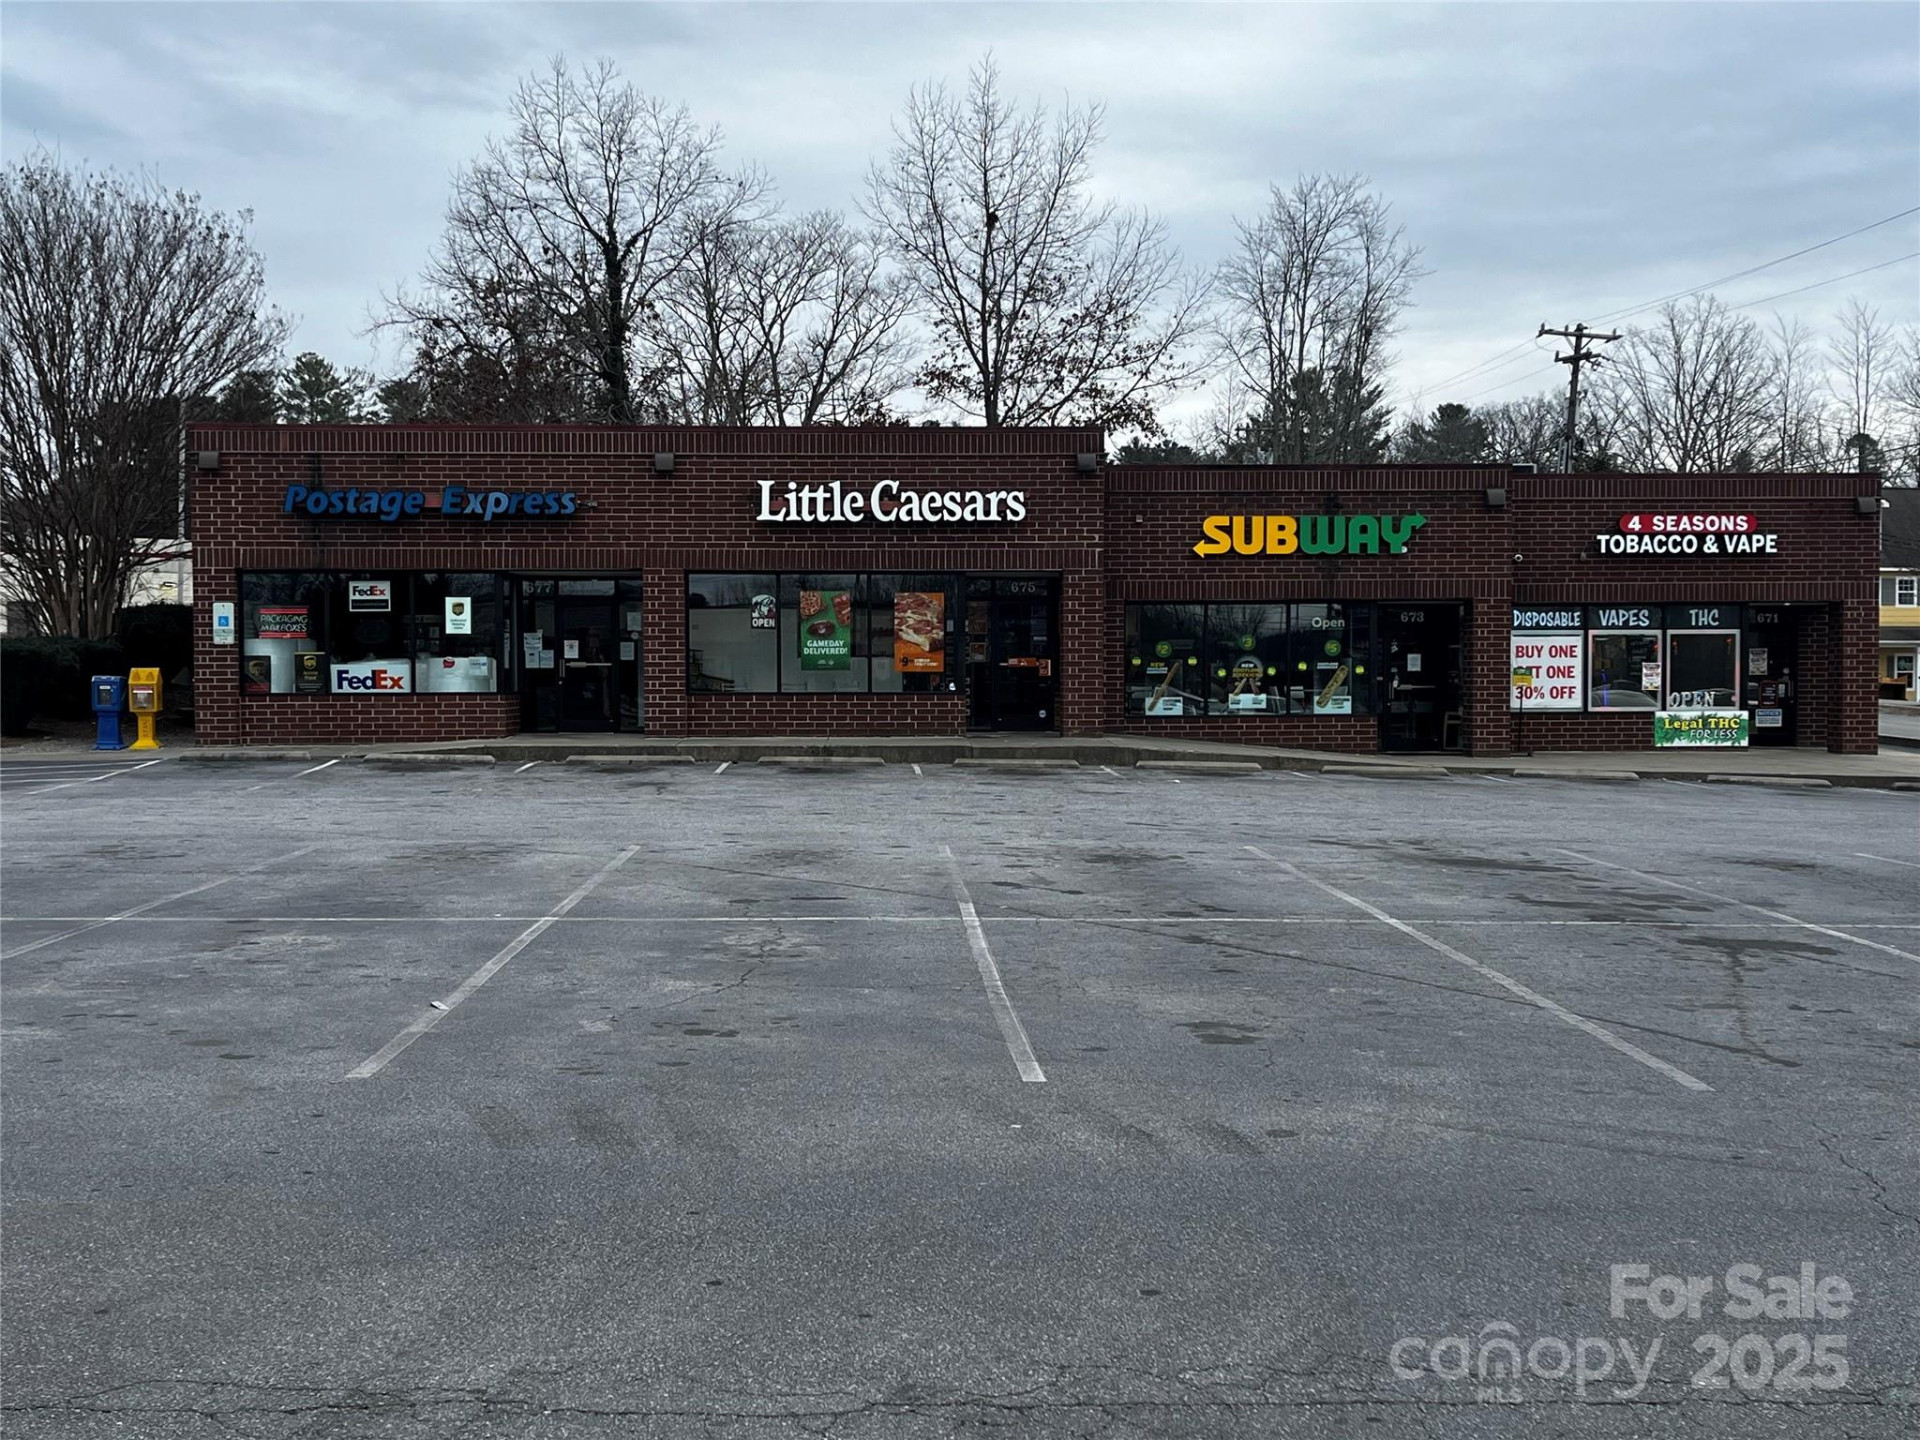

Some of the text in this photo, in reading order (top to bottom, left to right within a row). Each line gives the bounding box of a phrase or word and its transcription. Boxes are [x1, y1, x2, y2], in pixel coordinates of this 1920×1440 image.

[283, 484, 577, 521] Postage Express
[756, 480, 1026, 522] Little Caesars
[1628, 515, 1748, 531] 4 SEASONS
[1193, 512, 1428, 558] SUBWAY
[1597, 534, 1778, 554] TOBACCO & VAPE
[352, 585, 386, 597] FedEx
[1010, 581, 1036, 593] 675
[260, 614, 308, 623] PACKAGING
[752, 618, 775, 628] OPEN
[1311, 617, 1345, 630] Open
[1400, 611, 1425, 623] 673
[1513, 610, 1581, 627] DISPOSABLE
[1599, 609, 1650, 626] VAPES
[1689, 609, 1720, 626] THC
[1757, 613, 1779, 623] 671
[260, 623, 307, 632] MAILBOXES
[806, 639, 845, 648] GAMEDAY
[803, 647, 848, 655] DELIVERED!
[1515, 645, 1578, 658] BUY ONE
[1546, 666, 1575, 678] ONE
[337, 669, 405, 690] FedEx
[1515, 686, 1576, 699] 30% OFF
[1669, 691, 1716, 708] OPEN
[1664, 718, 1740, 730] Legal THC
[1690, 729, 1738, 739] FOR LESS
